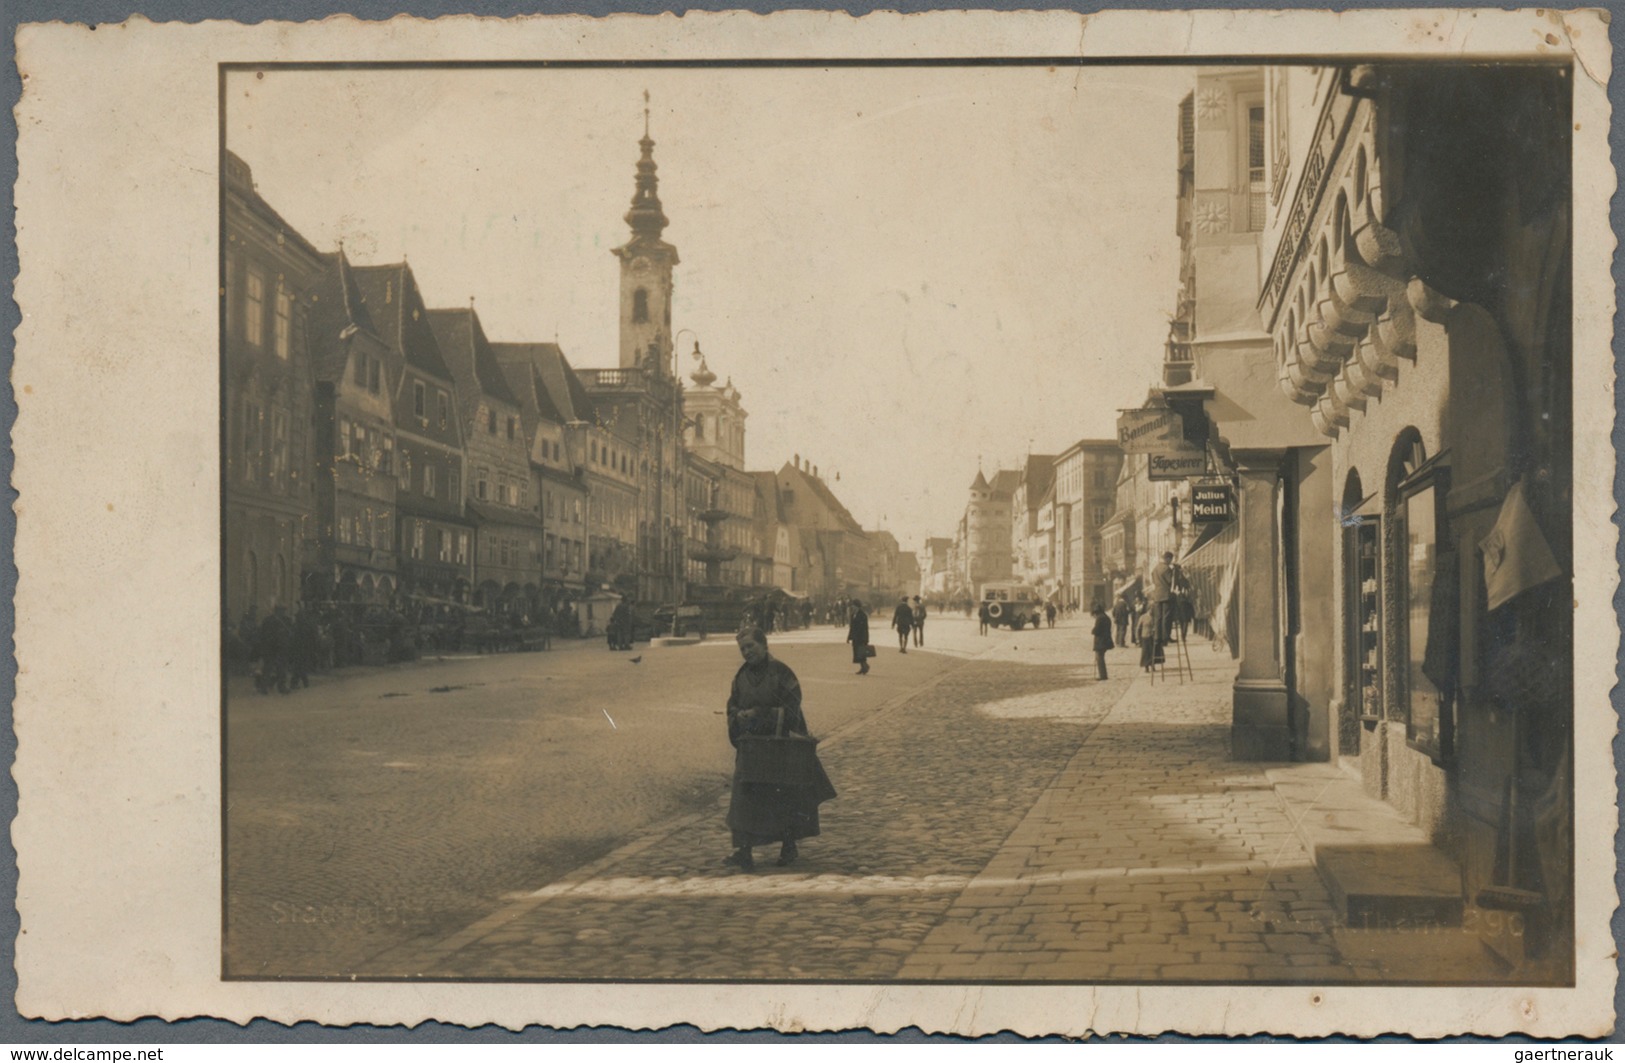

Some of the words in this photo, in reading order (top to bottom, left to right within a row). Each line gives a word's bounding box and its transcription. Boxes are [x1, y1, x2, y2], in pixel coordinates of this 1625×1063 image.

[1151, 455, 1204, 473] Tapezierer
[1195, 491, 1225, 500] Julius
[1193, 503, 1228, 516] Meinl
